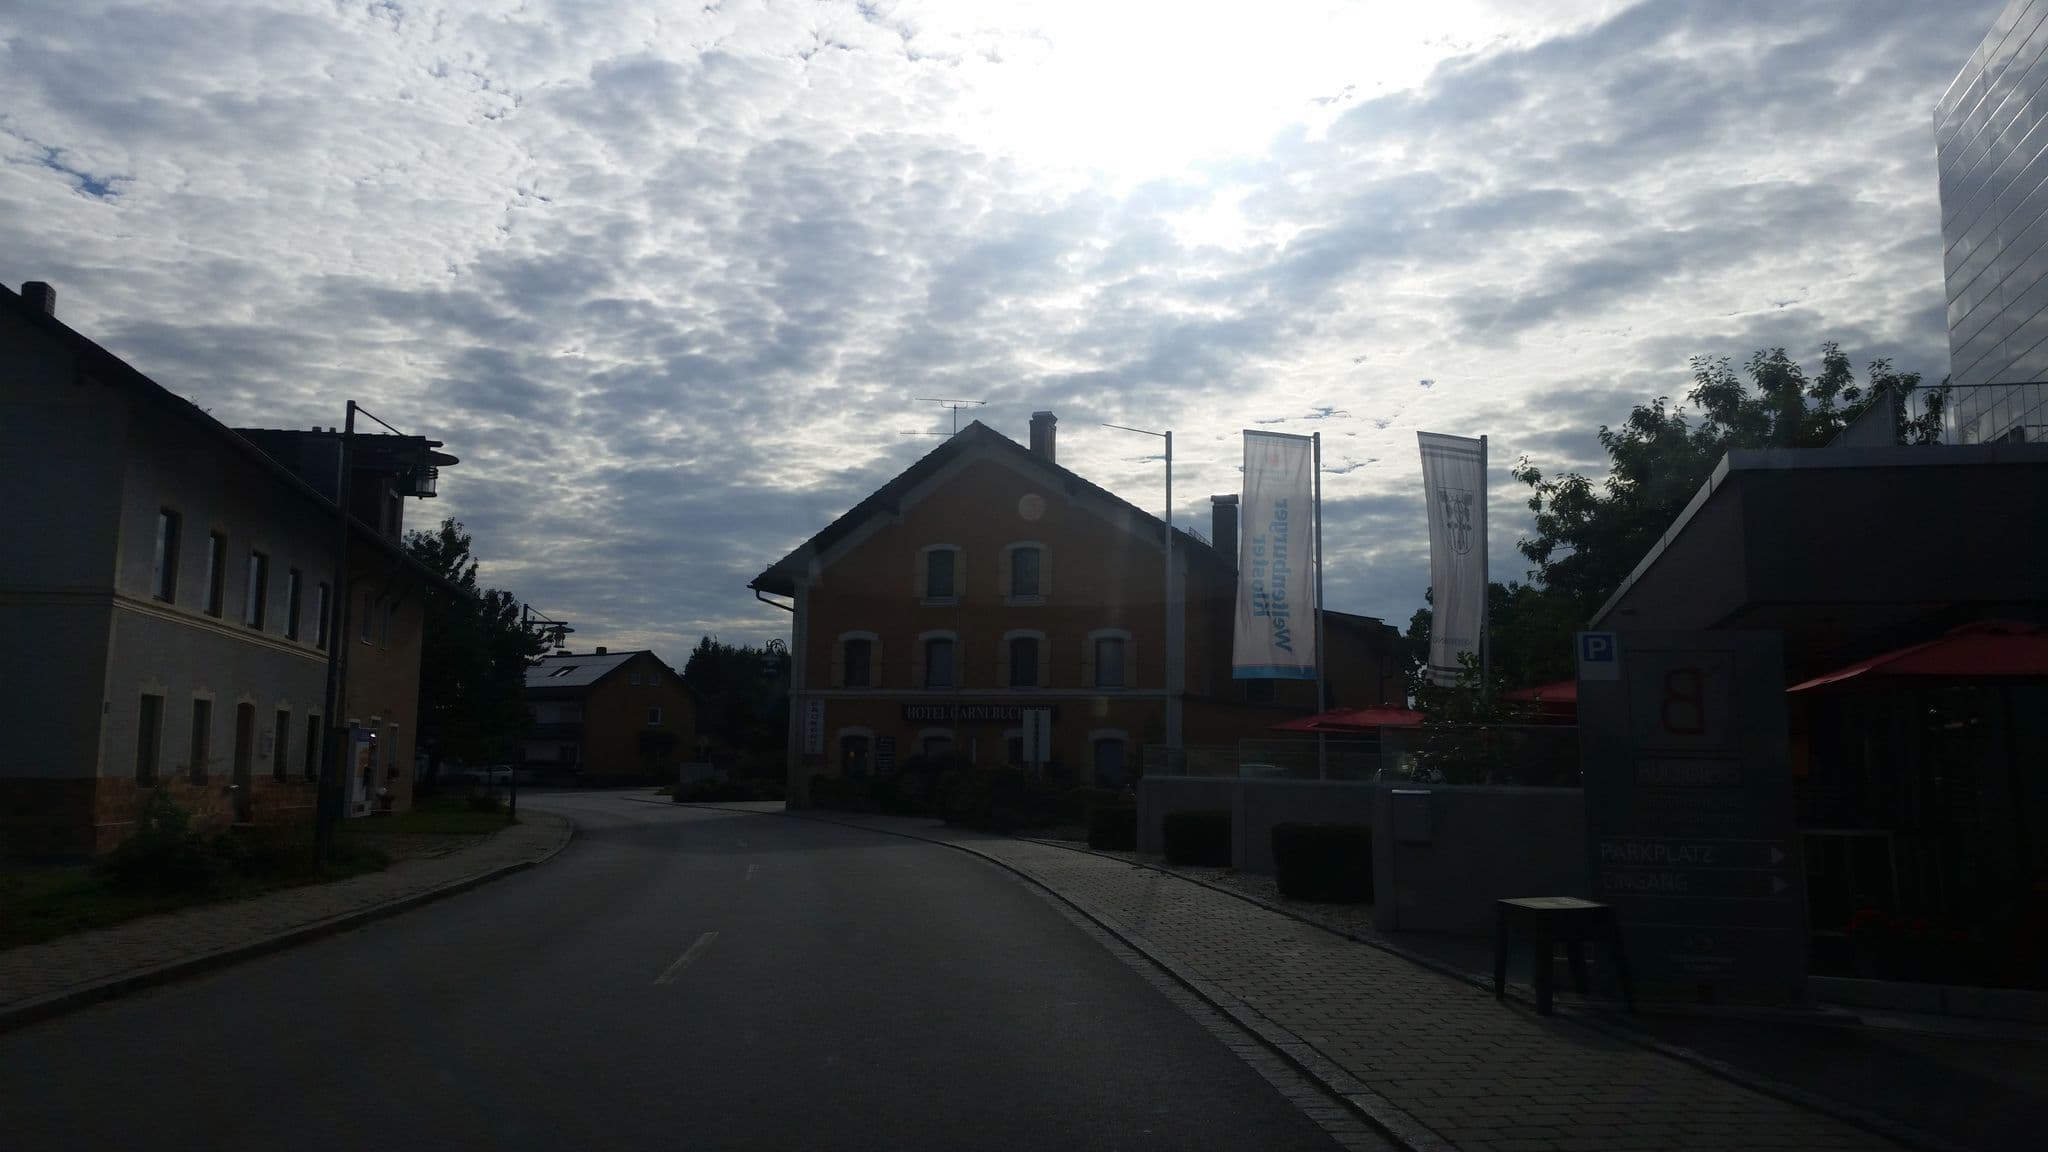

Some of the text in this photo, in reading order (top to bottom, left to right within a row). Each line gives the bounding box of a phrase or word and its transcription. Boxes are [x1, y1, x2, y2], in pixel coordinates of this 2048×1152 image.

[1588, 637, 1607, 659] P
[906, 705, 945, 720] HOTEL
[1600, 842, 1713, 863] PARKPLATZ
